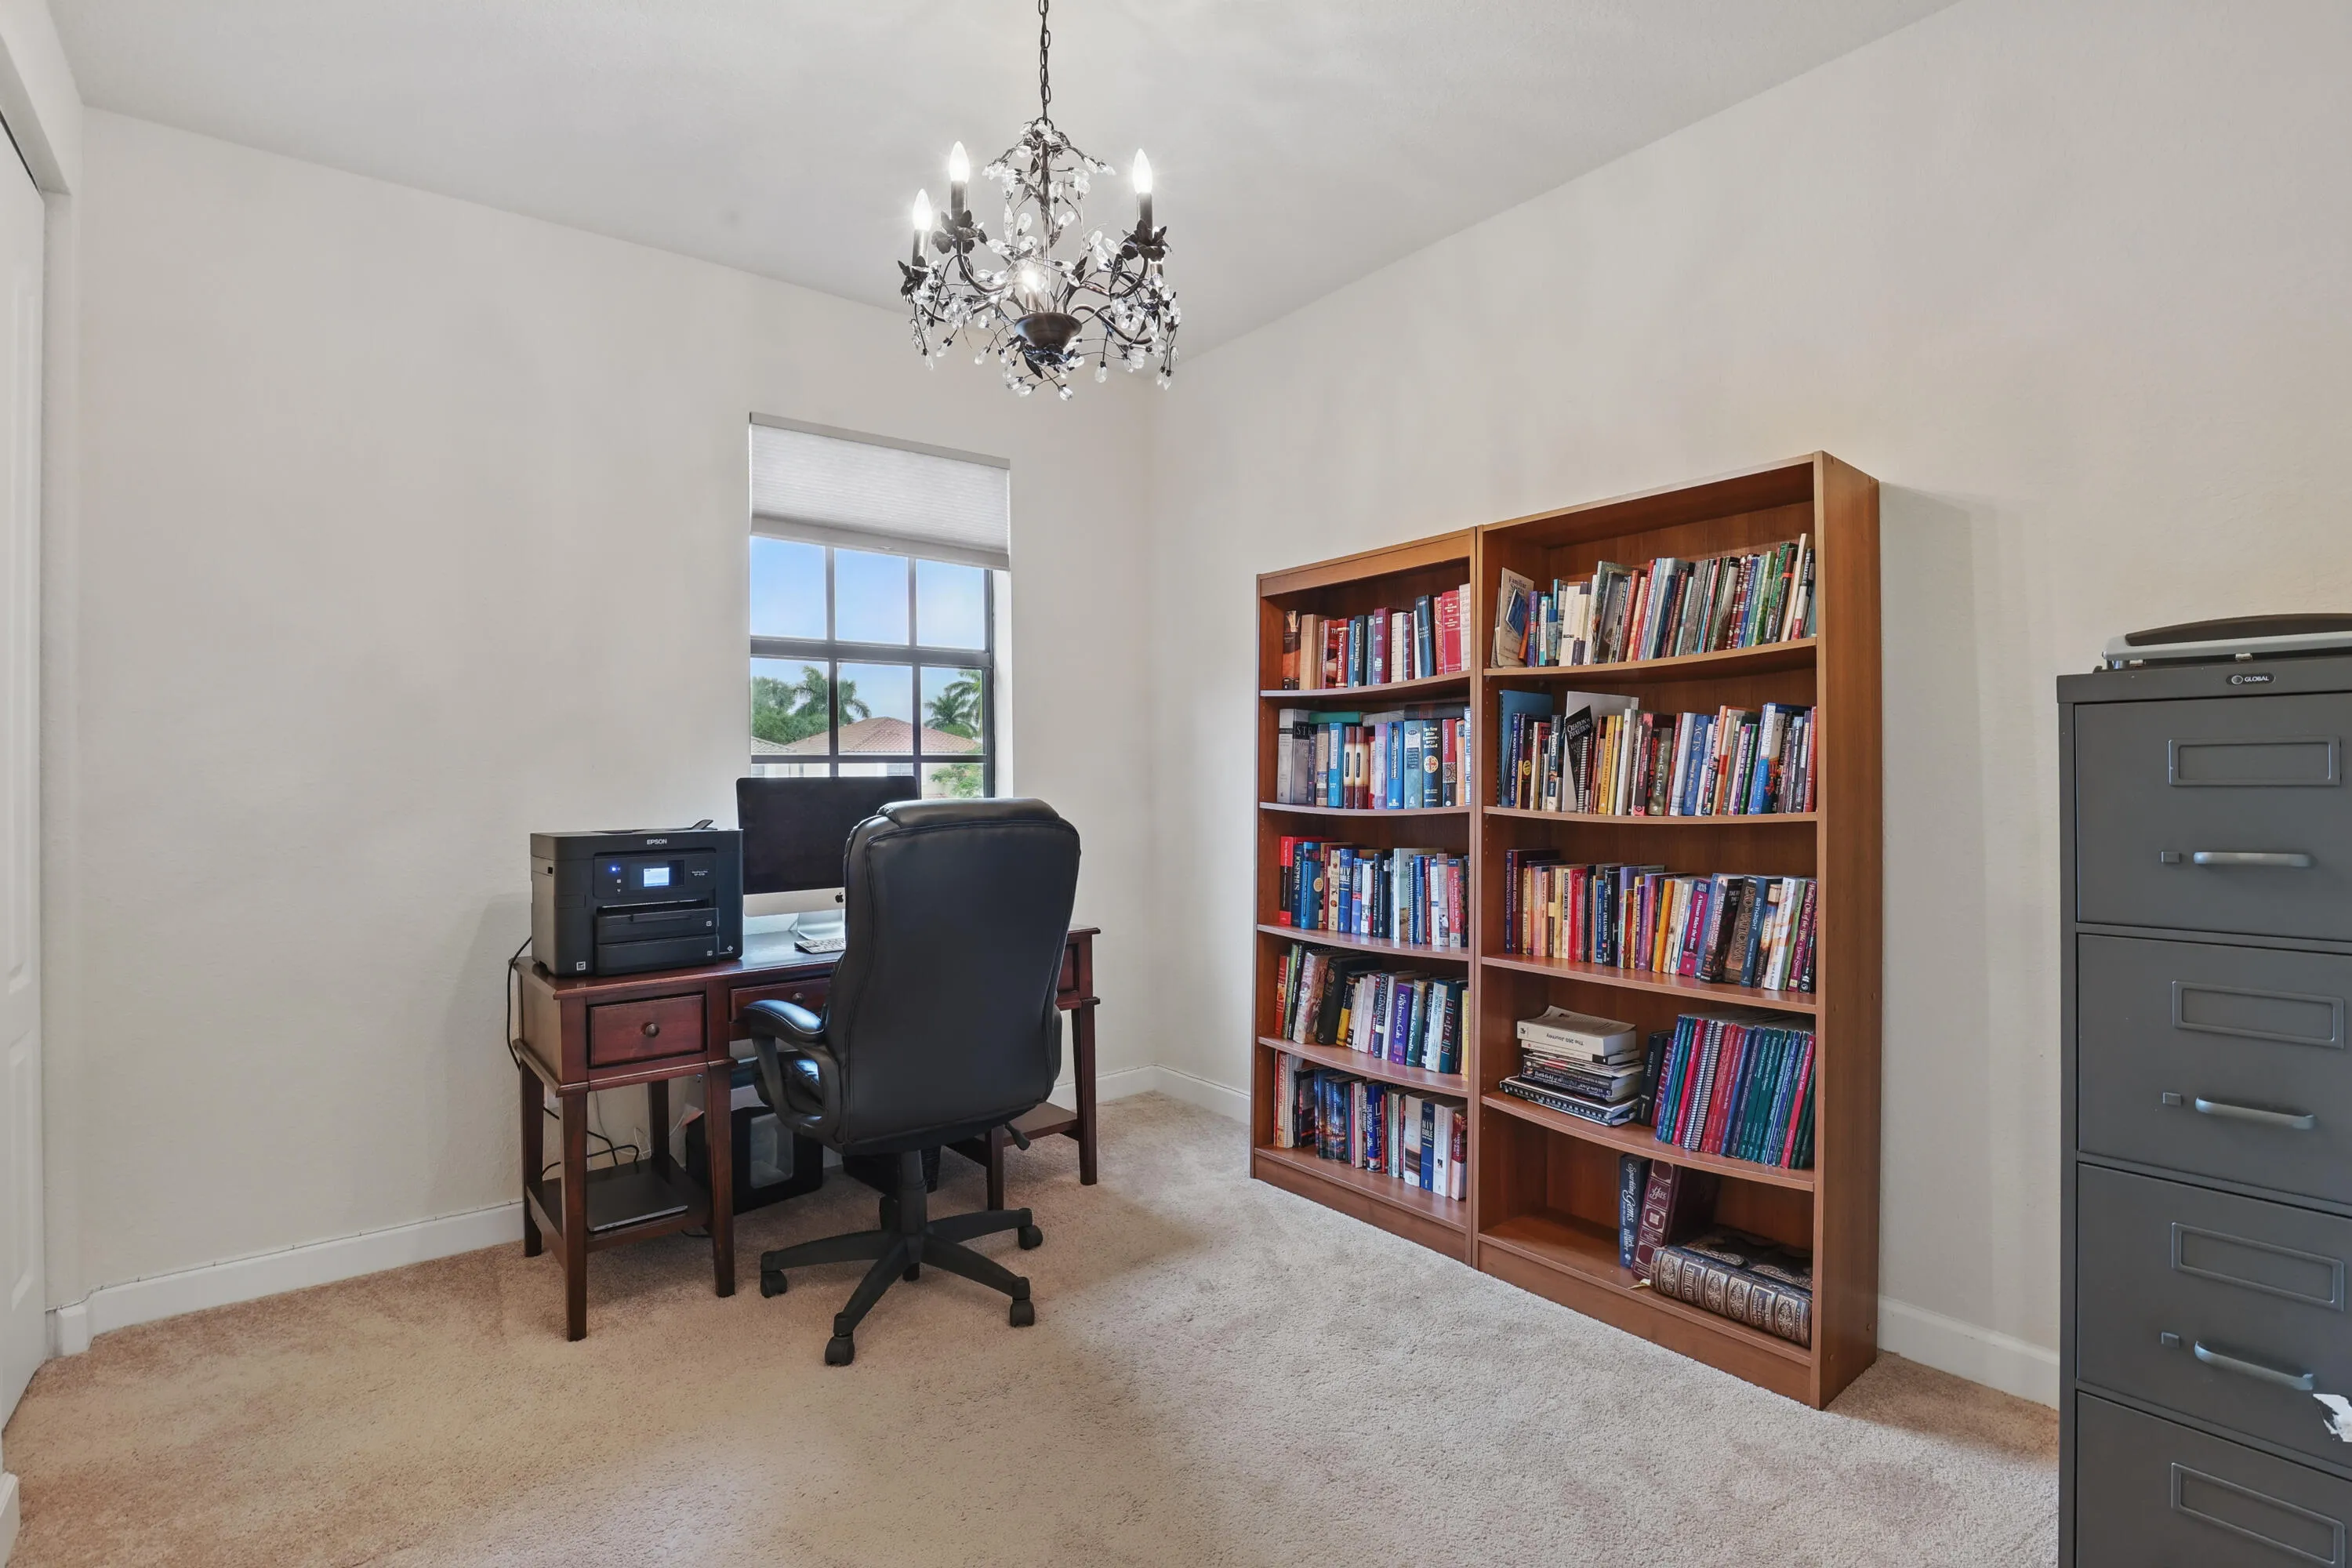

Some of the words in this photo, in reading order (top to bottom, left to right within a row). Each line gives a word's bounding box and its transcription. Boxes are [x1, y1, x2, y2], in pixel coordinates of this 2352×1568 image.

[1802, 553, 1811, 584] UNSHAKABLE
[1693, 724, 1703, 752] ACTS
[1805, 884, 1814, 903] Healing
[1752, 897, 1761, 930] BIRTHRIGHT
[1377, 995, 1386, 1025] GENERALS
[1546, 1033, 1564, 1042] Journey
[1625, 1163, 1636, 1196] Sparkling
[1622, 1190, 1636, 1222] Gems
[1686, 1267, 1695, 1289] BIBLE
